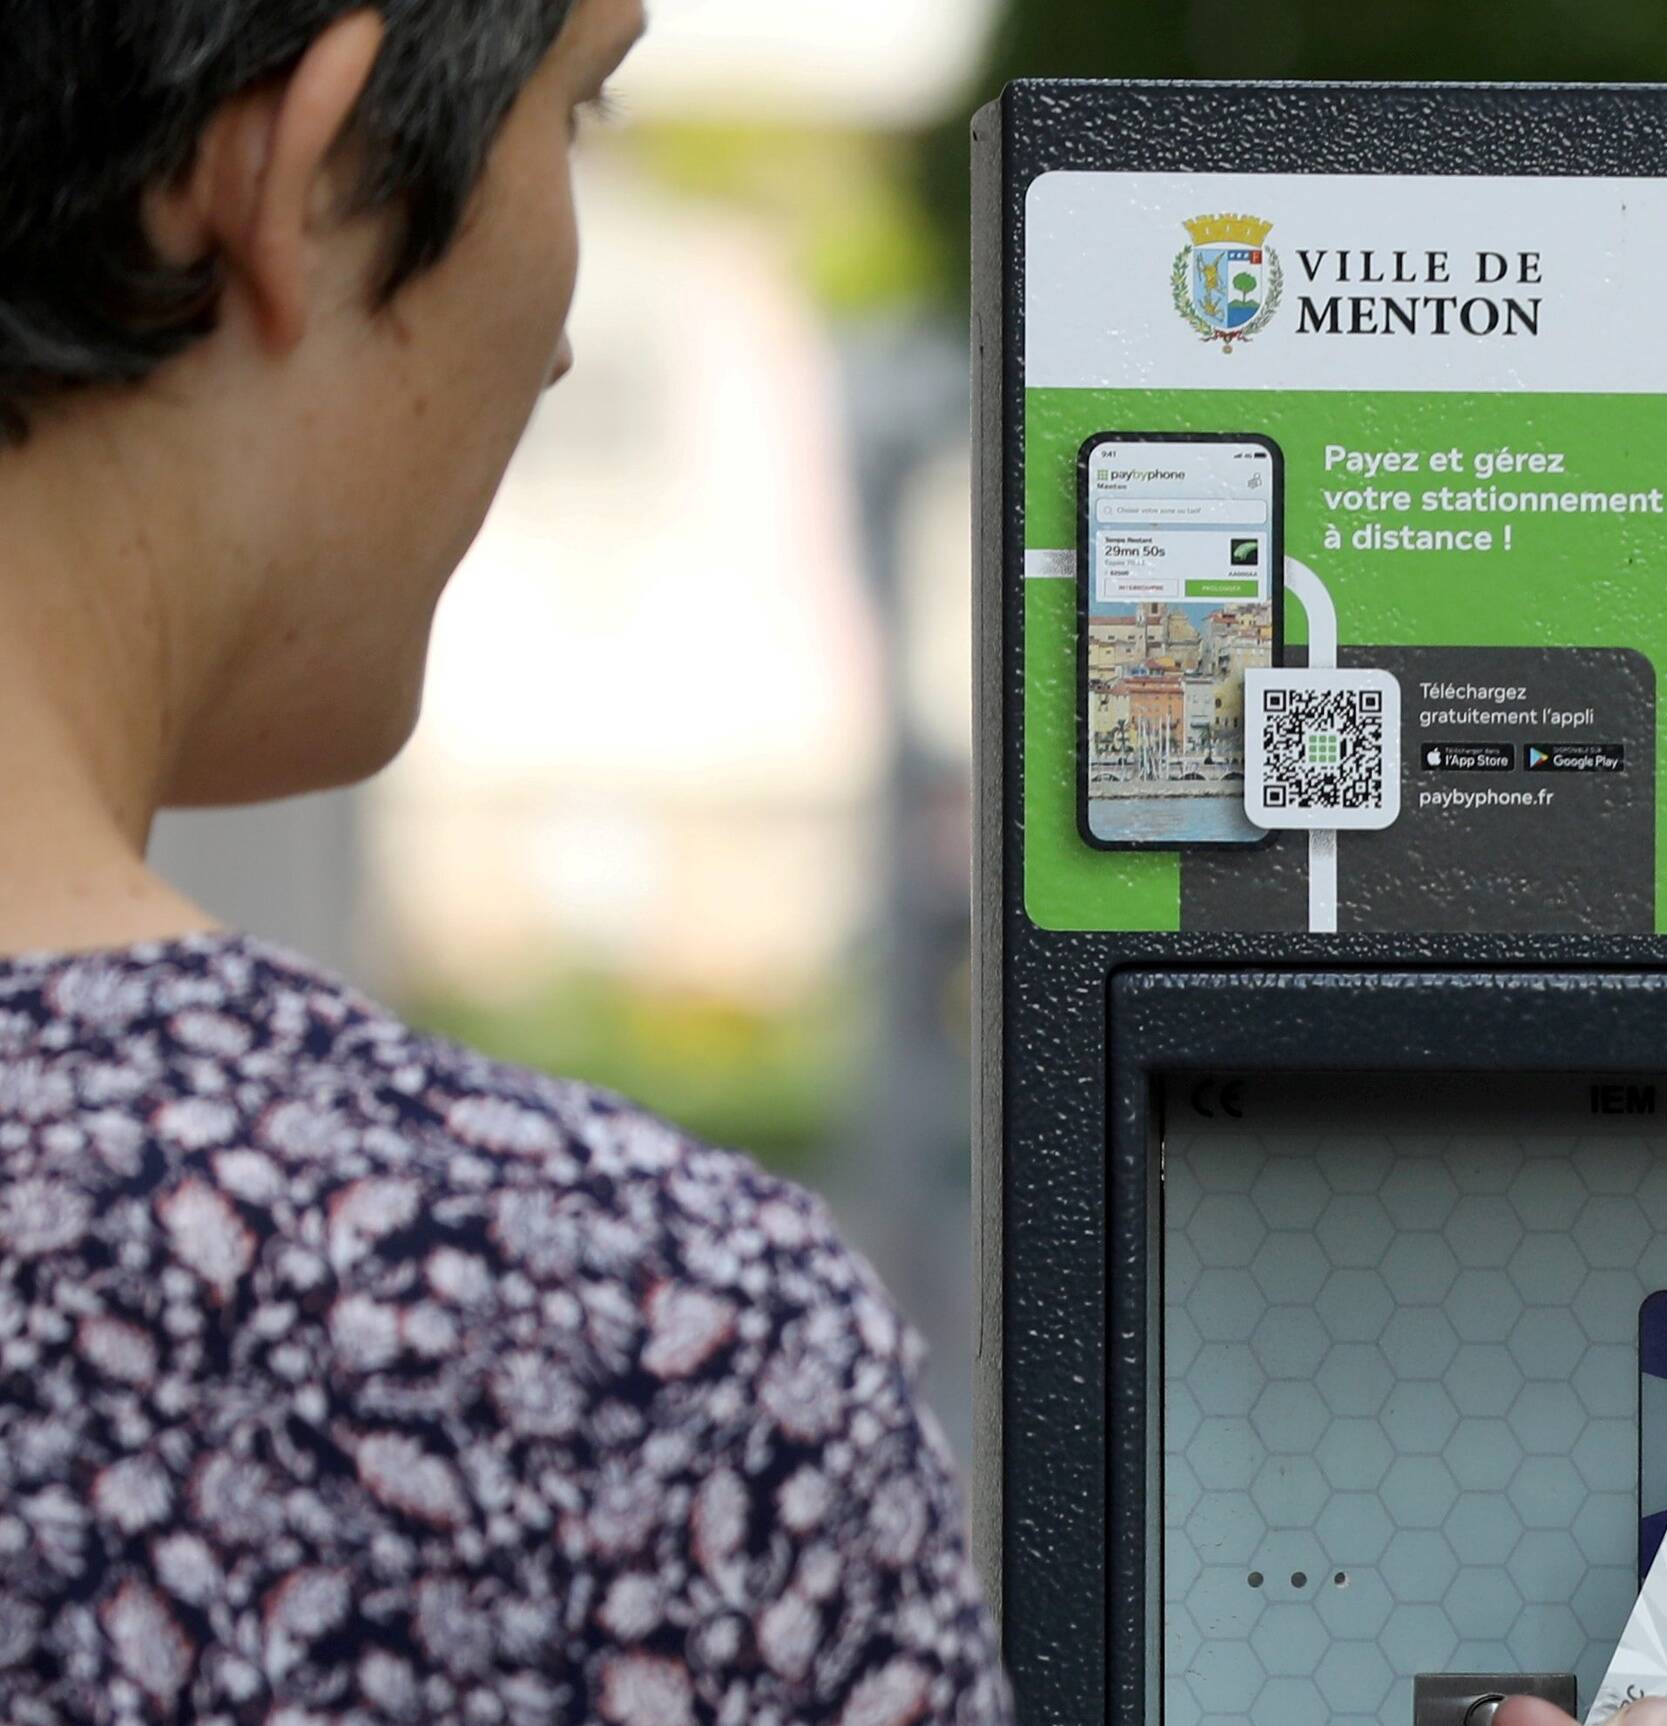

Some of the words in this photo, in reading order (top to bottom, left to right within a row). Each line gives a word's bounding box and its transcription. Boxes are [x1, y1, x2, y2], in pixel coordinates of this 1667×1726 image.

[1296, 250, 1450, 283] VILLE
[1475, 251, 1542, 284] DE
[1295, 296, 1542, 336] MENTON
[1324, 445, 1419, 477] Payez
[1429, 449, 1463, 473] et
[1474, 447, 1565, 479] gérez
[1111, 469, 1185, 482] paybyphone
[1324, 487, 1411, 511] votre
[1422, 486, 1664, 513] stationnement
[1324, 524, 1341, 550] à
[1352, 524, 1493, 550] distance
[1504, 525, 1512, 550] !
[1105, 545, 1139, 557] 29mn
[1143, 545, 1166, 557] 50s
[1420, 682, 1527, 704] Téléchargez
[1419, 708, 1538, 727] gratuitement
[1477, 754, 1508, 767] Store
[1553, 755, 1594, 769] Google
[1595, 755, 1618, 769] Play
[1419, 788, 1555, 809] paybyphone.fr
[1591, 1085, 1656, 1114] IEM
